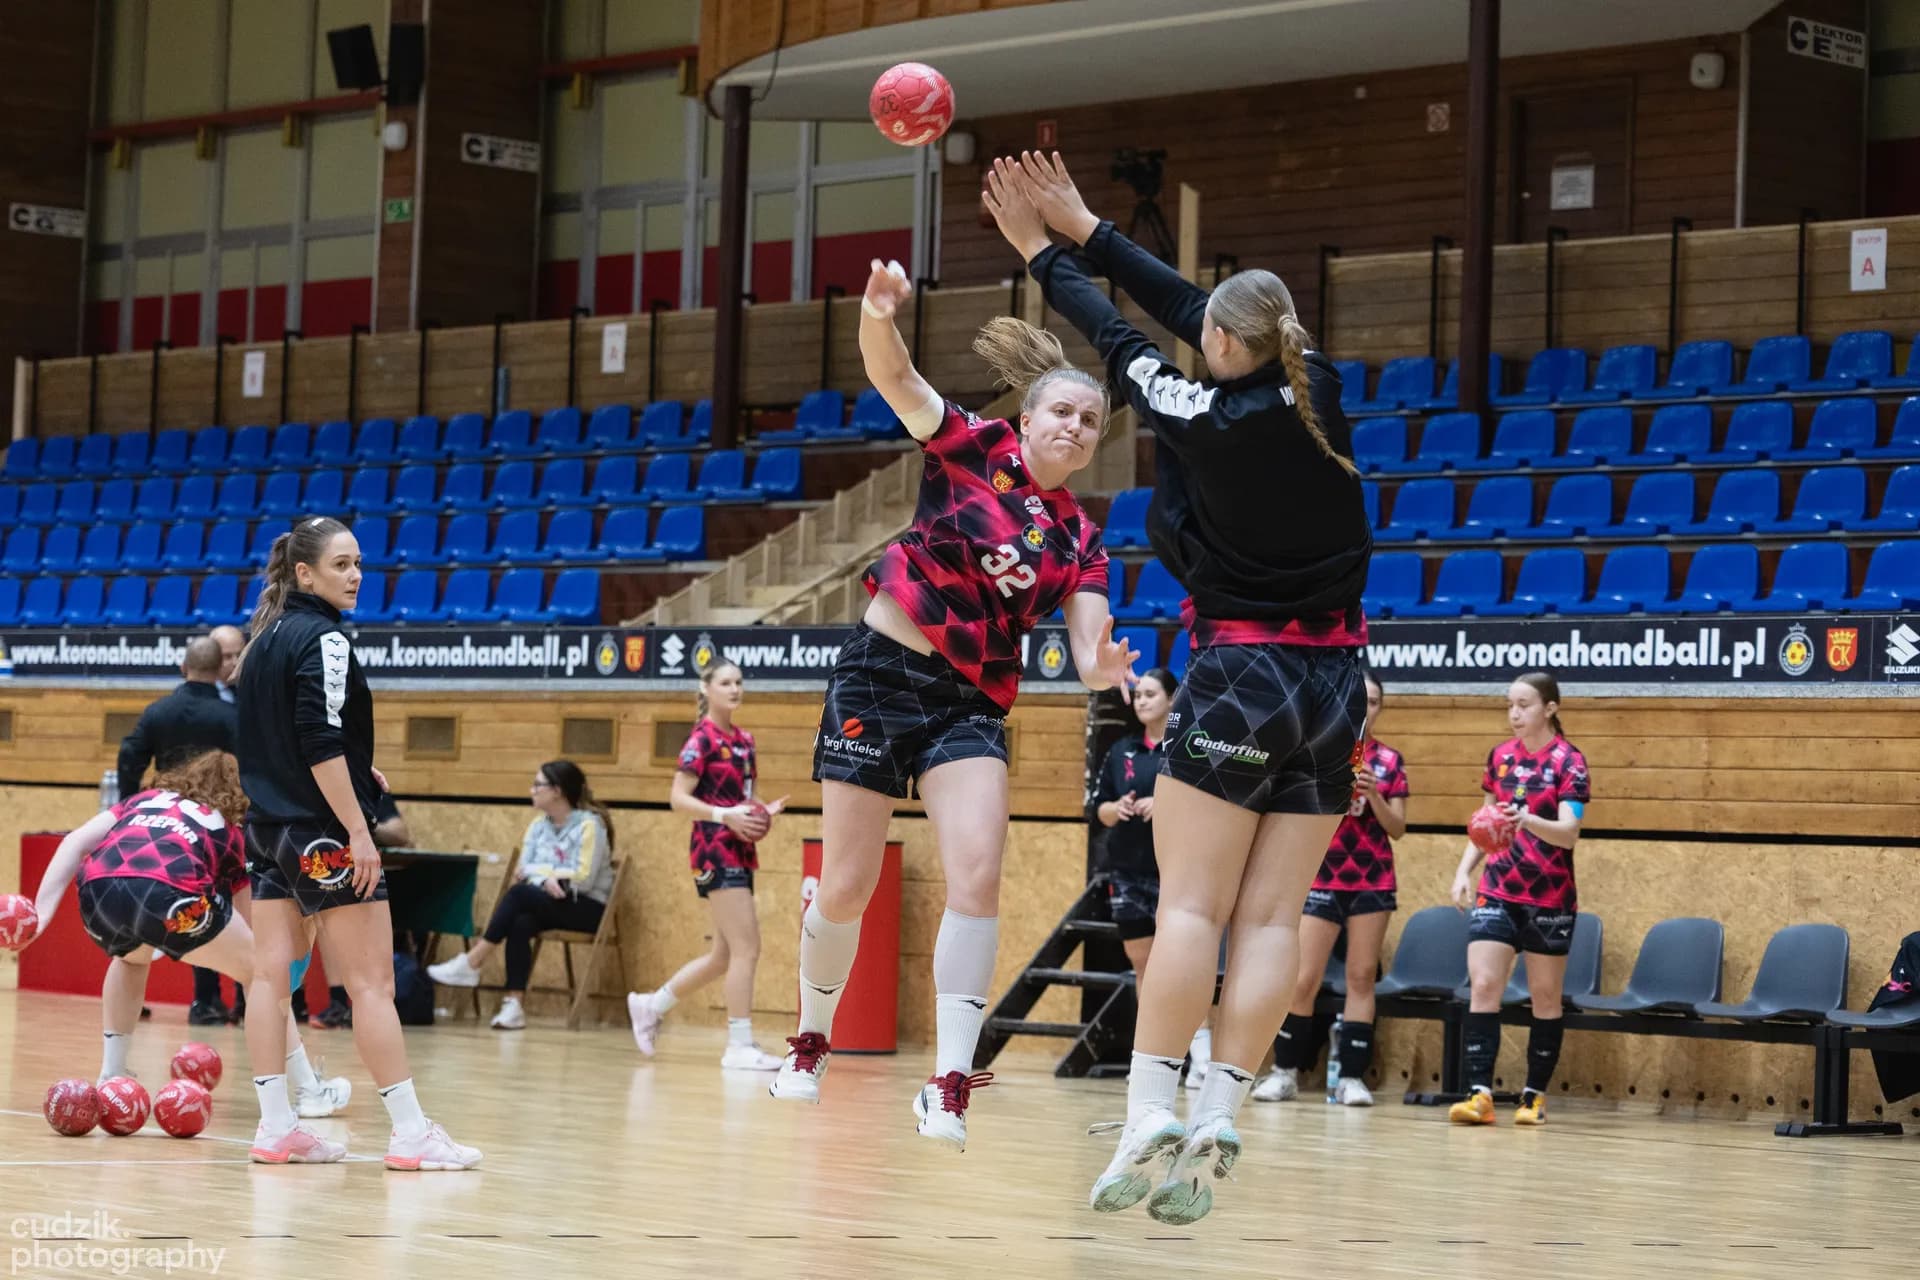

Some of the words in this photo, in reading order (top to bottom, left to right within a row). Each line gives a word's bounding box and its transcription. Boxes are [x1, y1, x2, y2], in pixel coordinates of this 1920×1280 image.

[1813, 24, 1863, 45] SEKTOR
[1813, 35, 1832, 59] E
[1861, 256, 1875, 277] A
[981, 543, 1037, 599] 32
[11, 635, 188, 666] www.koronahandba
[352, 635, 590, 677] ww.koronahandball.pl
[1367, 627, 1766, 678] www.koronahandball.pl
[1829, 645, 1851, 667] CK
[1884, 665, 1920, 674] SUZUKI
[823, 735, 844, 752] Targi
[845, 740, 882, 757] Kielce
[1193, 737, 1270, 761] endorfina
[128, 814, 199, 844] RZEPKA
